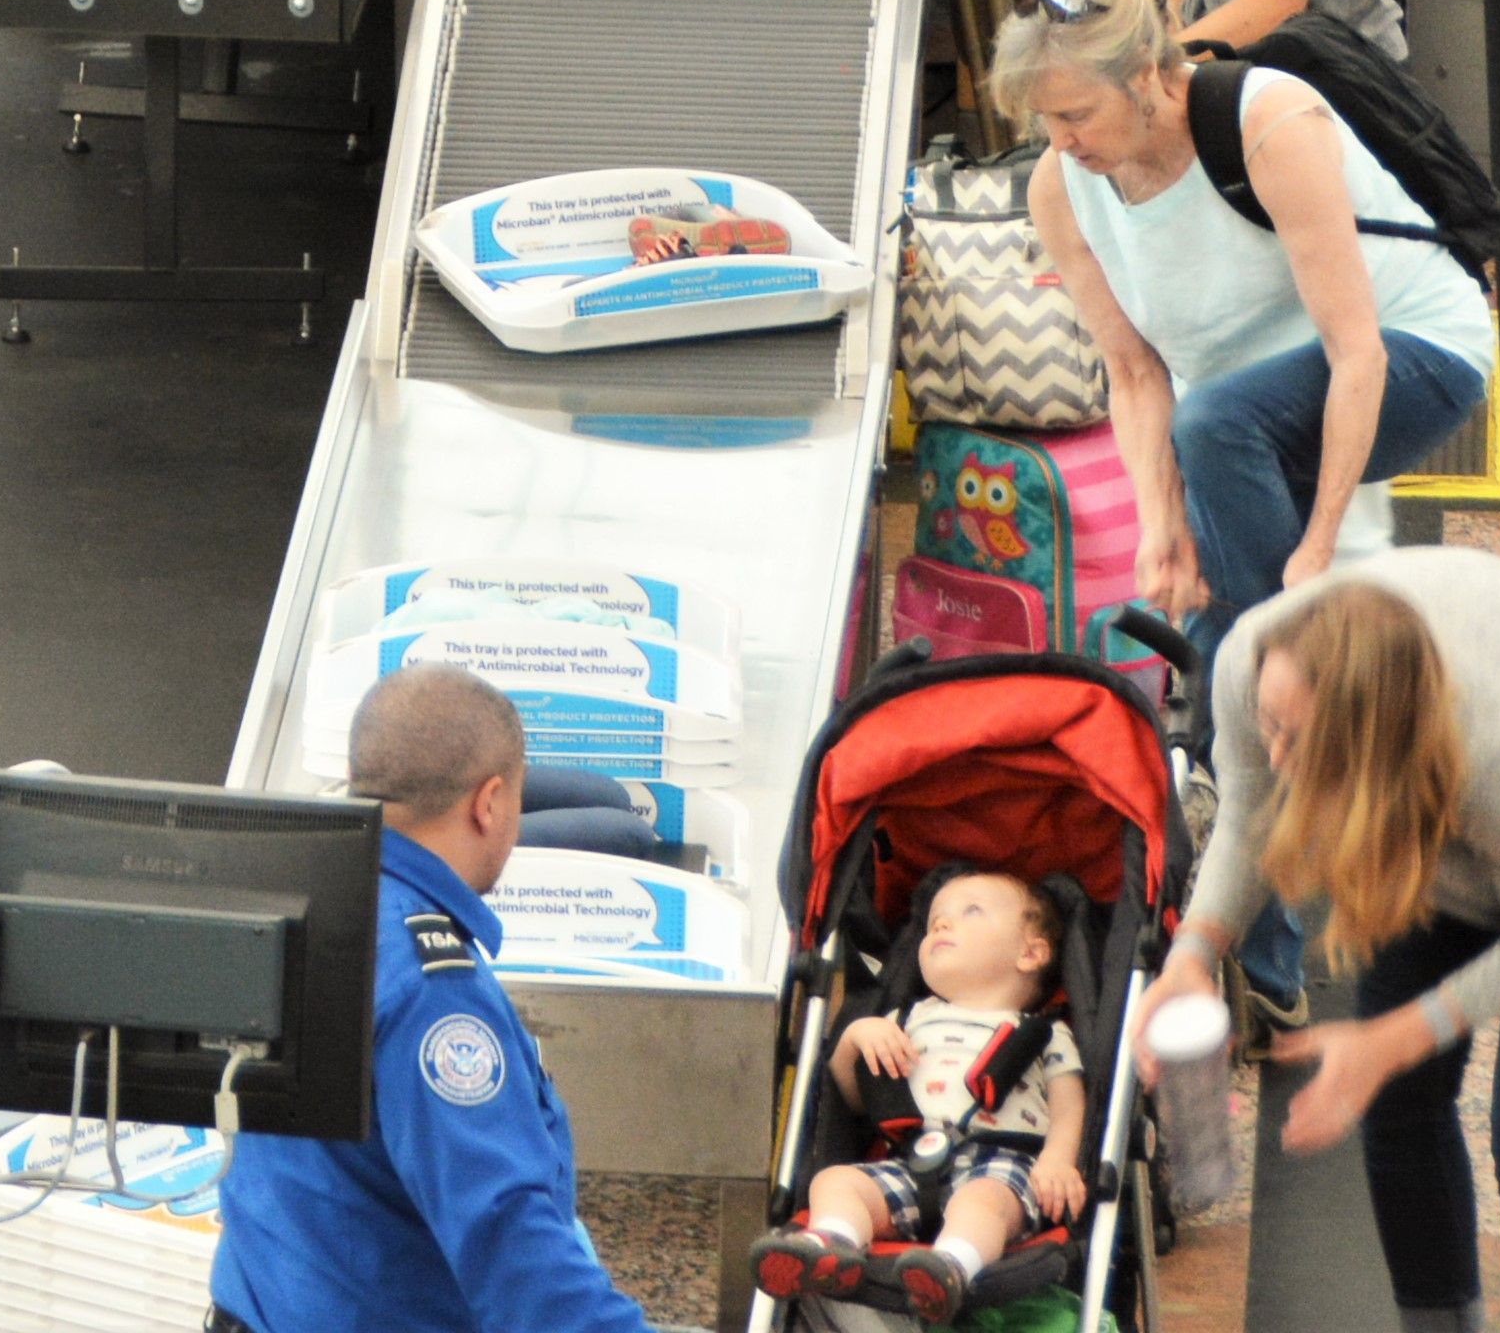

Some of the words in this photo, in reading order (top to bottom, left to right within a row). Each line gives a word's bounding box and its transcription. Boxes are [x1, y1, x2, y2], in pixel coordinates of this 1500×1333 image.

[527, 200, 553, 213] This
[553, 198, 577, 212] tray
[578, 197, 588, 207] is
[589, 192, 646, 210] protected
[647, 188, 672, 201] with
[558, 207, 636, 225] Antimicrobial
[448, 578, 474, 590] This
[504, 579, 514, 591] is
[516, 580, 579, 594] protected
[581, 582, 609, 594] with
[935, 589, 983, 622] Josie
[445, 641, 472, 654] This
[474, 643, 499, 657] tray
[501, 643, 512, 656] is
[515, 644, 579, 659] protected
[580, 646, 608, 659] with
[477, 658, 566, 674] Antimicrobial
[570, 661, 645, 677] Technology
[537, 711, 587, 722] PRODUCT
[588, 712, 657, 724] PROTECTION
[503, 884, 515, 896] is
[517, 885, 582, 900] protected
[585, 887, 613, 899] with
[574, 904, 651, 919] Technology
[416, 931, 462, 950] TSA
